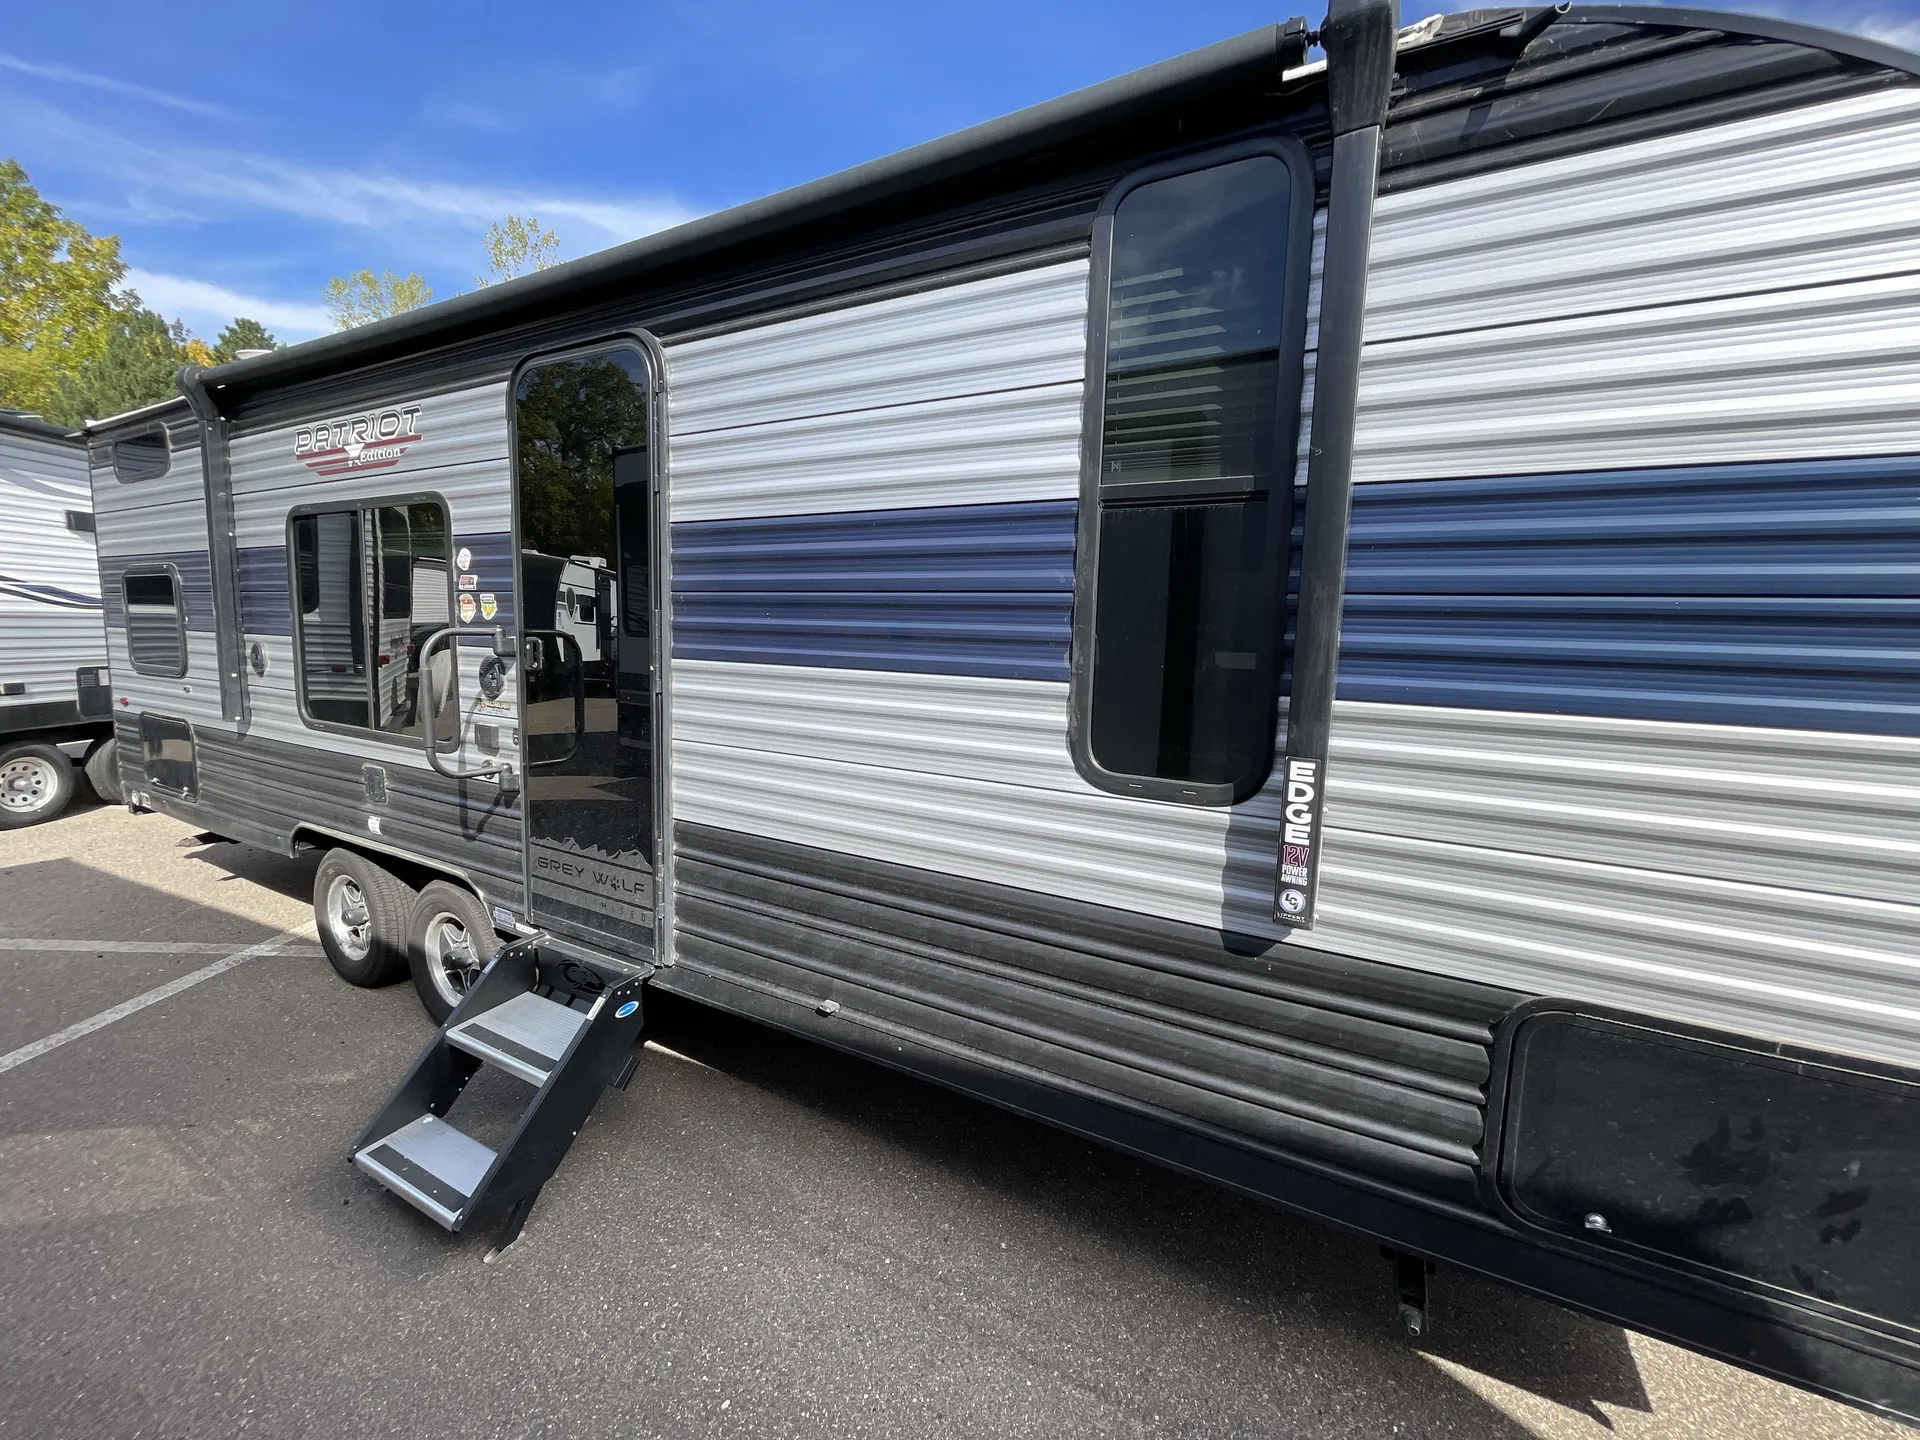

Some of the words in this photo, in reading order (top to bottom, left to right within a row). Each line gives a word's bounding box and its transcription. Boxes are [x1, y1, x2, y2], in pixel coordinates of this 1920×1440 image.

[294, 404, 423, 455] PATRIOT
[360, 447, 401, 462] Edition
[1284, 760, 1316, 846] EDGE
[537, 856, 585, 878] GREY
[1282, 844, 1310, 868] 12V
[1280, 873, 1308, 887] AWNING
[1281, 864, 1308, 878] POWER
